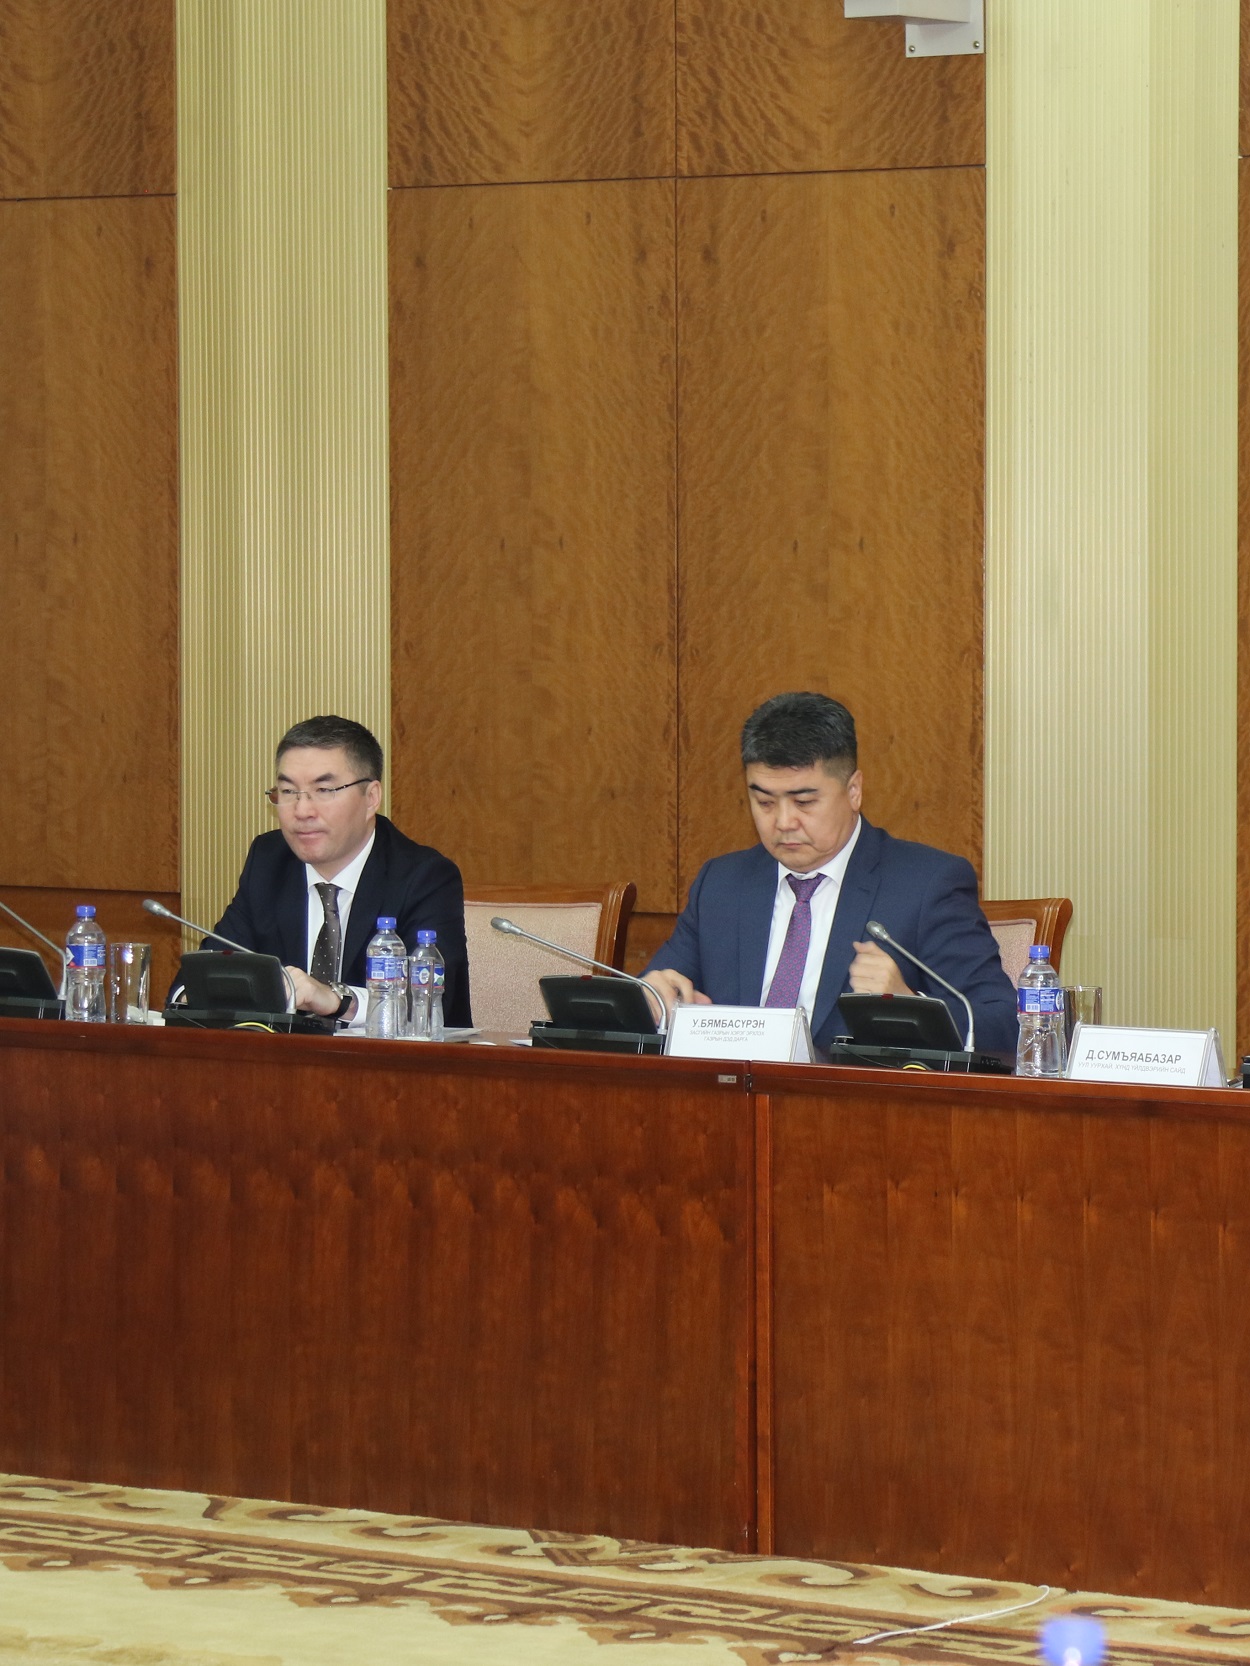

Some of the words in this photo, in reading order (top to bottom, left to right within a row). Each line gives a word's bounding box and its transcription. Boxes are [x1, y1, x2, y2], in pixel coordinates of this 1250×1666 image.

[692, 1018, 765, 1028] У.БЯМБАСҮРЭН
[1085, 1049, 1182, 1064] Д.СУМЪЯАБАЗАР
[1115, 1063, 1130, 1071] ХҮНД
[1131, 1064, 1169, 1073] ҮЙЛДВЭРИЙН
[1169, 1066, 1186, 1074] САЙД
